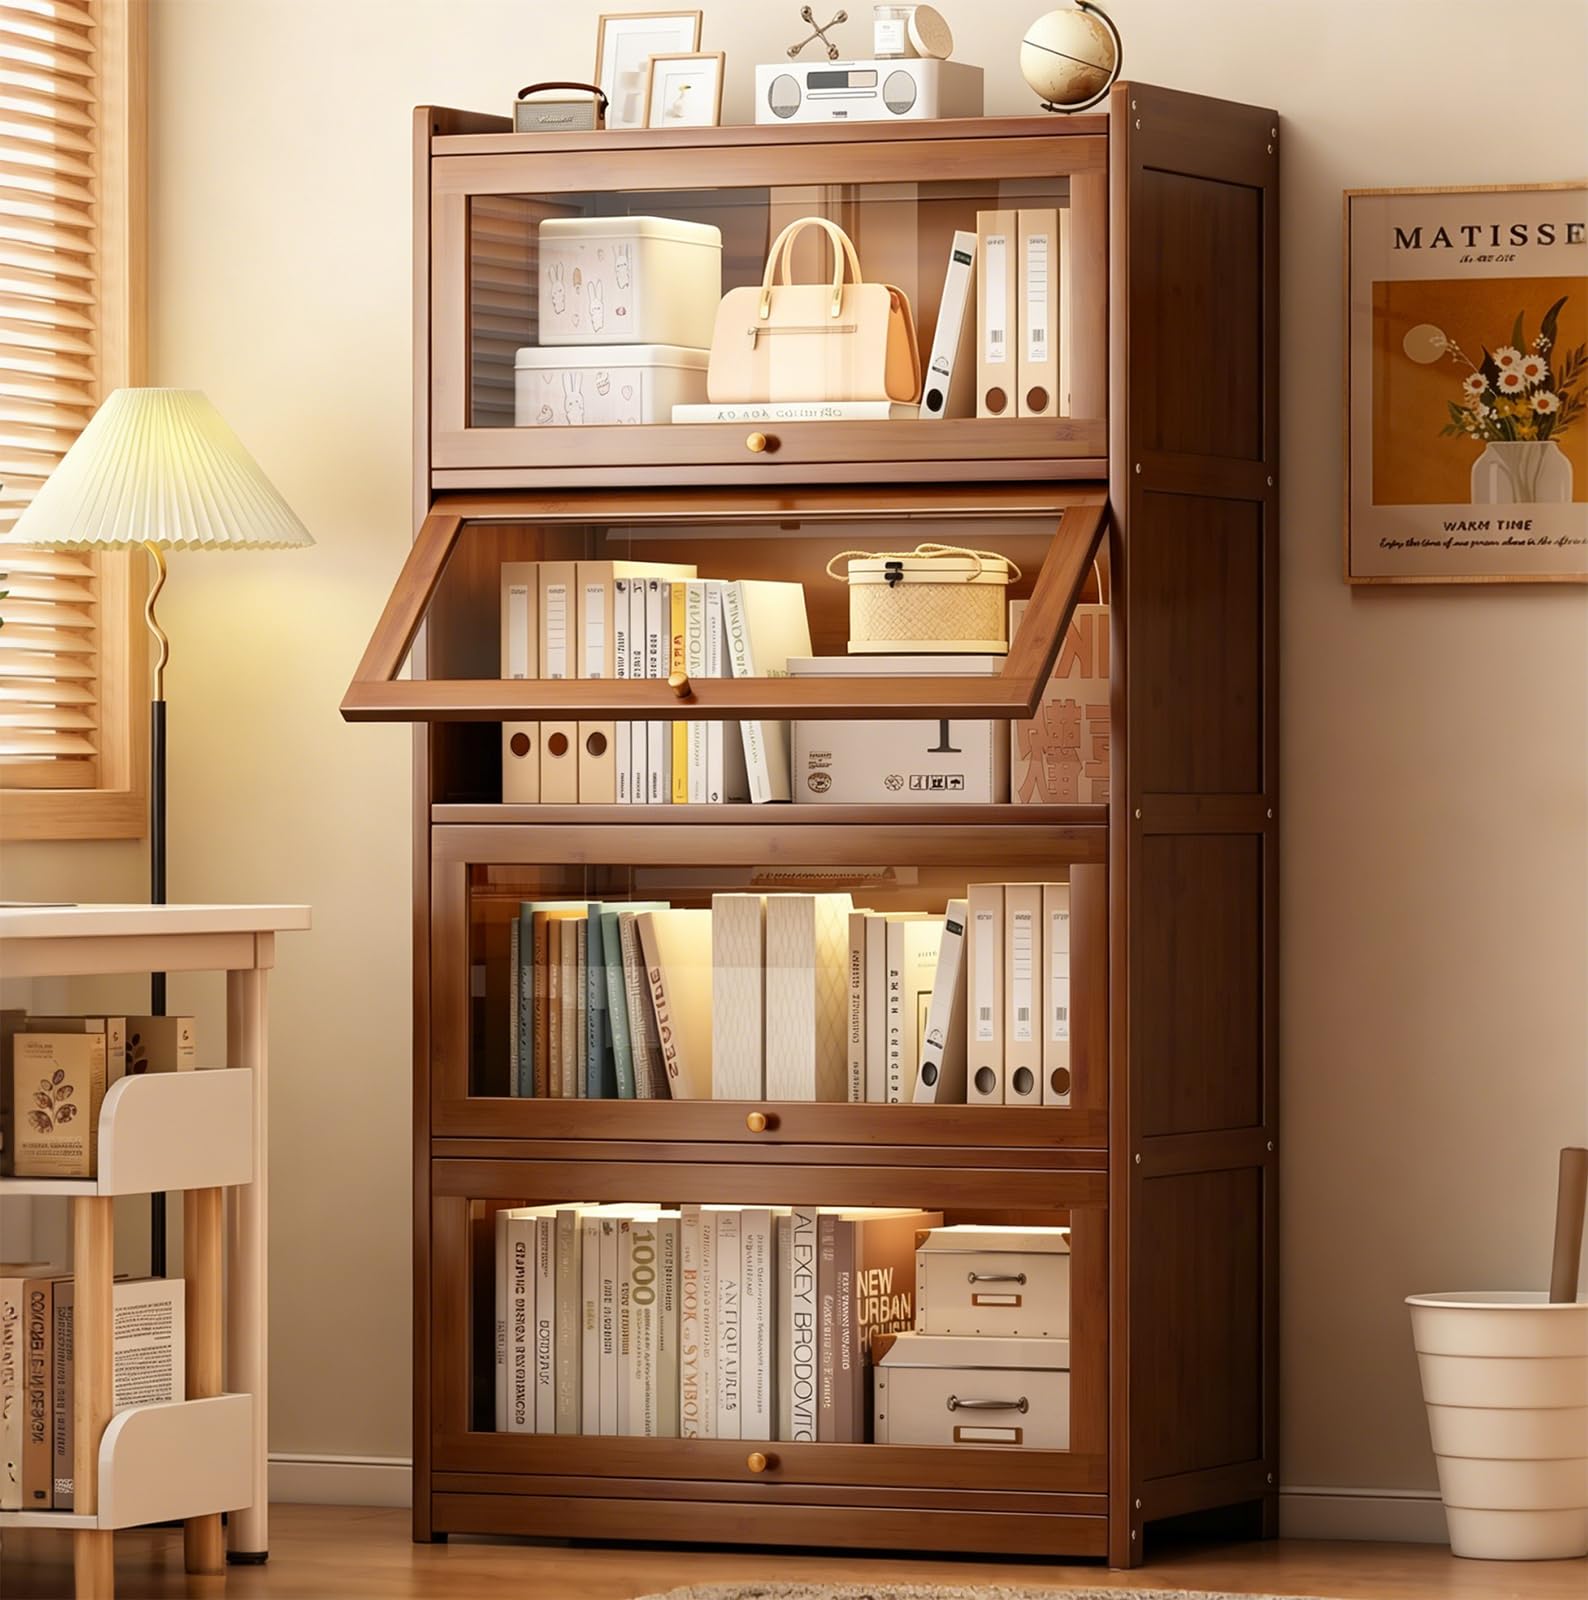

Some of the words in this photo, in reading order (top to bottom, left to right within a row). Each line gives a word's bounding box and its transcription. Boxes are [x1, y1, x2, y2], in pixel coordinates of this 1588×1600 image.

[1393, 223, 1586, 249] MATISSE
[1497, 520, 1533, 531] TIME
[632, 1230, 655, 1305] 1000
[794, 1212, 813, 1304] ALEXEY
[856, 1267, 893, 1298] NEW
[857, 1292, 912, 1325] URBAN
